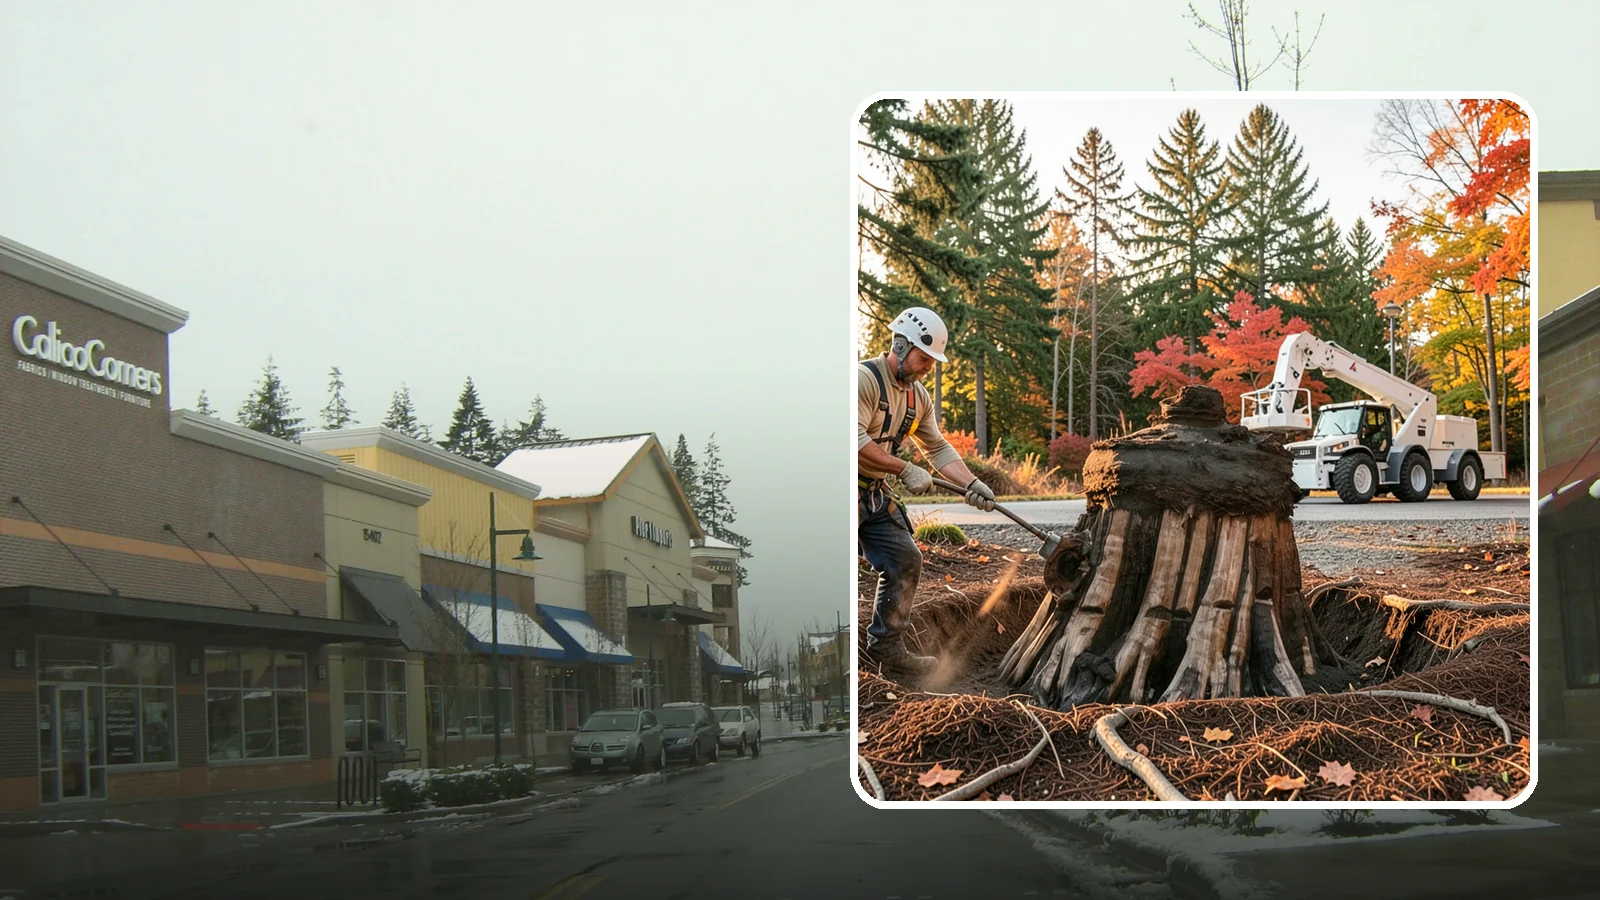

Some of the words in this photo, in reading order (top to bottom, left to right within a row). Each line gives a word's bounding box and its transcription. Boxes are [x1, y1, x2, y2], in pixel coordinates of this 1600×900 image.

[17, 360, 47, 377] FABRICS
[52, 370, 78, 386] WINDOW
[79, 379, 116, 398] TREATMENTS
[120, 391, 151, 408] FURNITURE
